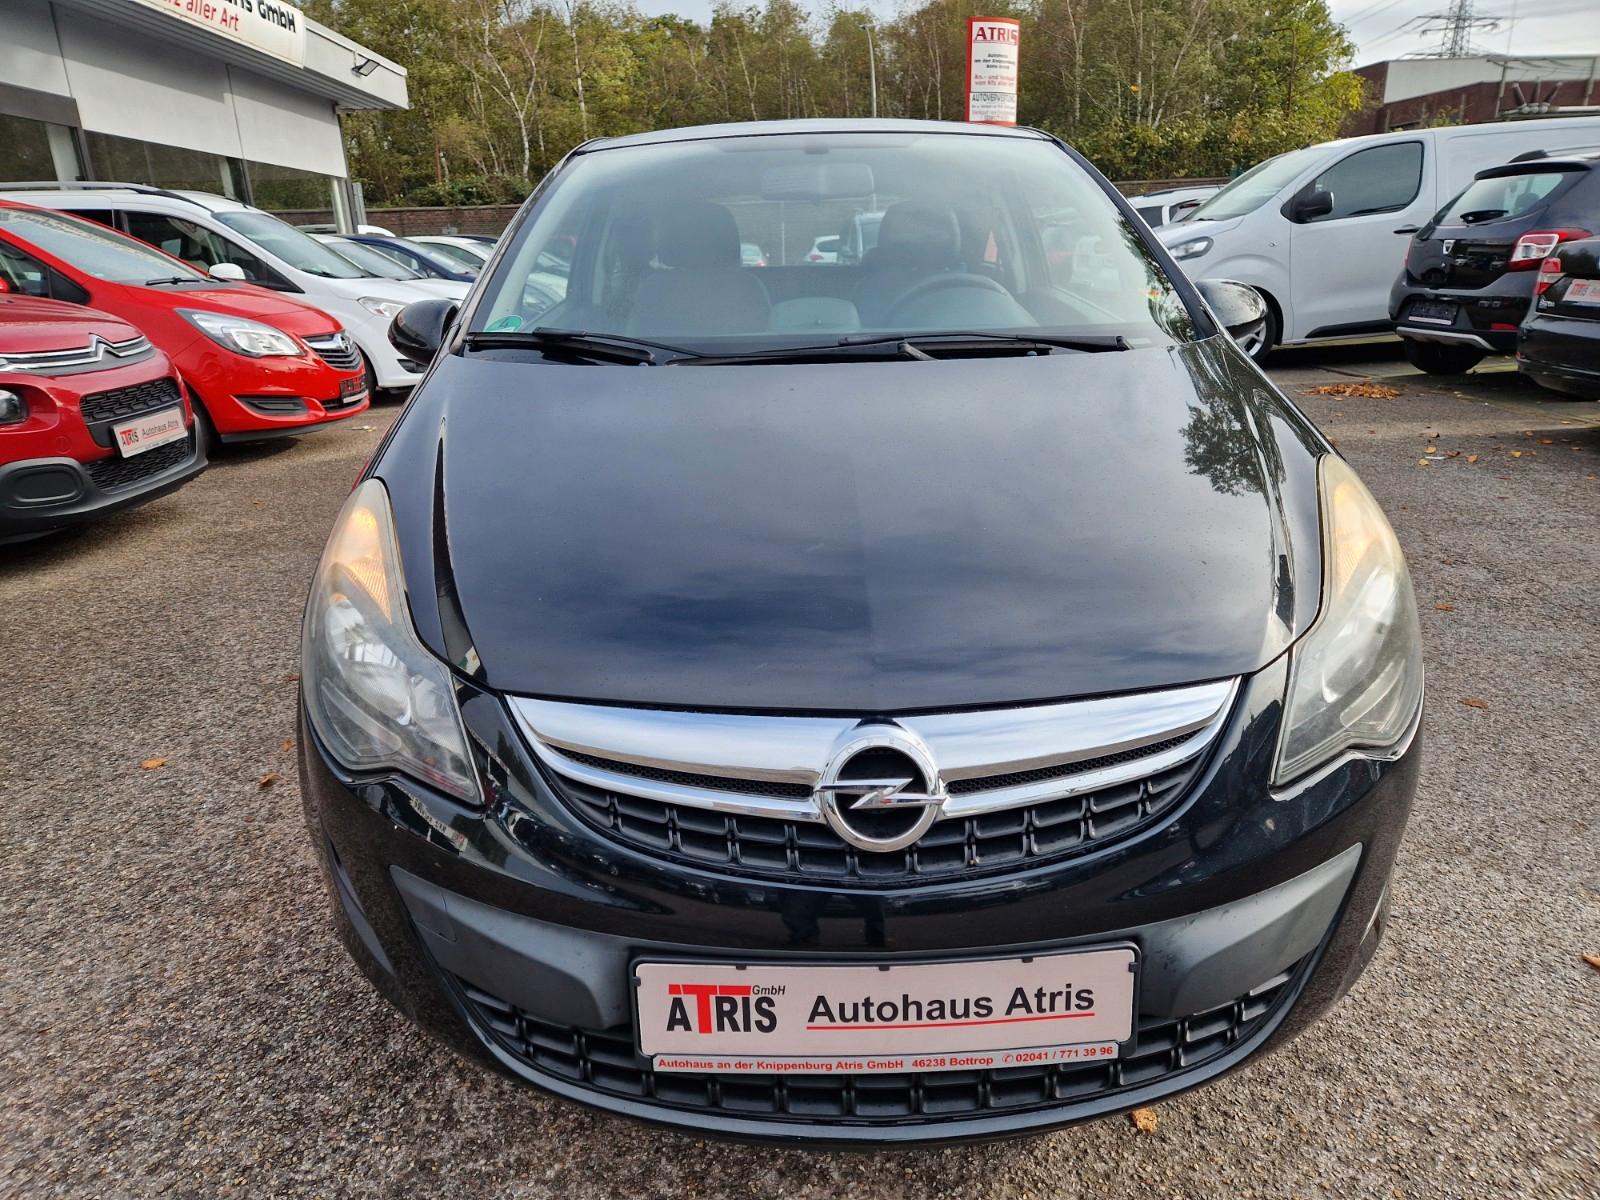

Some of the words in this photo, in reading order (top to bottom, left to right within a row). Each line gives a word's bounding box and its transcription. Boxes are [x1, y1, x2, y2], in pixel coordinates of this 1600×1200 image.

[186, 0, 217, 20] aller
[220, 8, 239, 31] Art
[257, 0, 297, 33] GmbH
[975, 26, 1018, 44] ATRIS
[666, 984, 778, 1034] ATRIS
[752, 984, 786, 996] GmbH
[808, 994, 993, 1024] Autohaus
[1005, 983, 1095, 1016] Atris
[658, 1059, 714, 1069] Autohaus
[734, 1061, 753, 1070] der
[757, 1061, 833, 1071] Knippenburg
[835, 1061, 864, 1070] Atris
[866, 1060, 903, 1070] GmbH
[911, 1058, 946, 1068] 46238
[949, 1056, 994, 1067] Bottrop
[1015, 1052, 1048, 1063] 02041
[1059, 1049, 1079, 1060] 771
[1083, 1047, 1097, 1057] 39
[1099, 1046, 1113, 1056] 96
